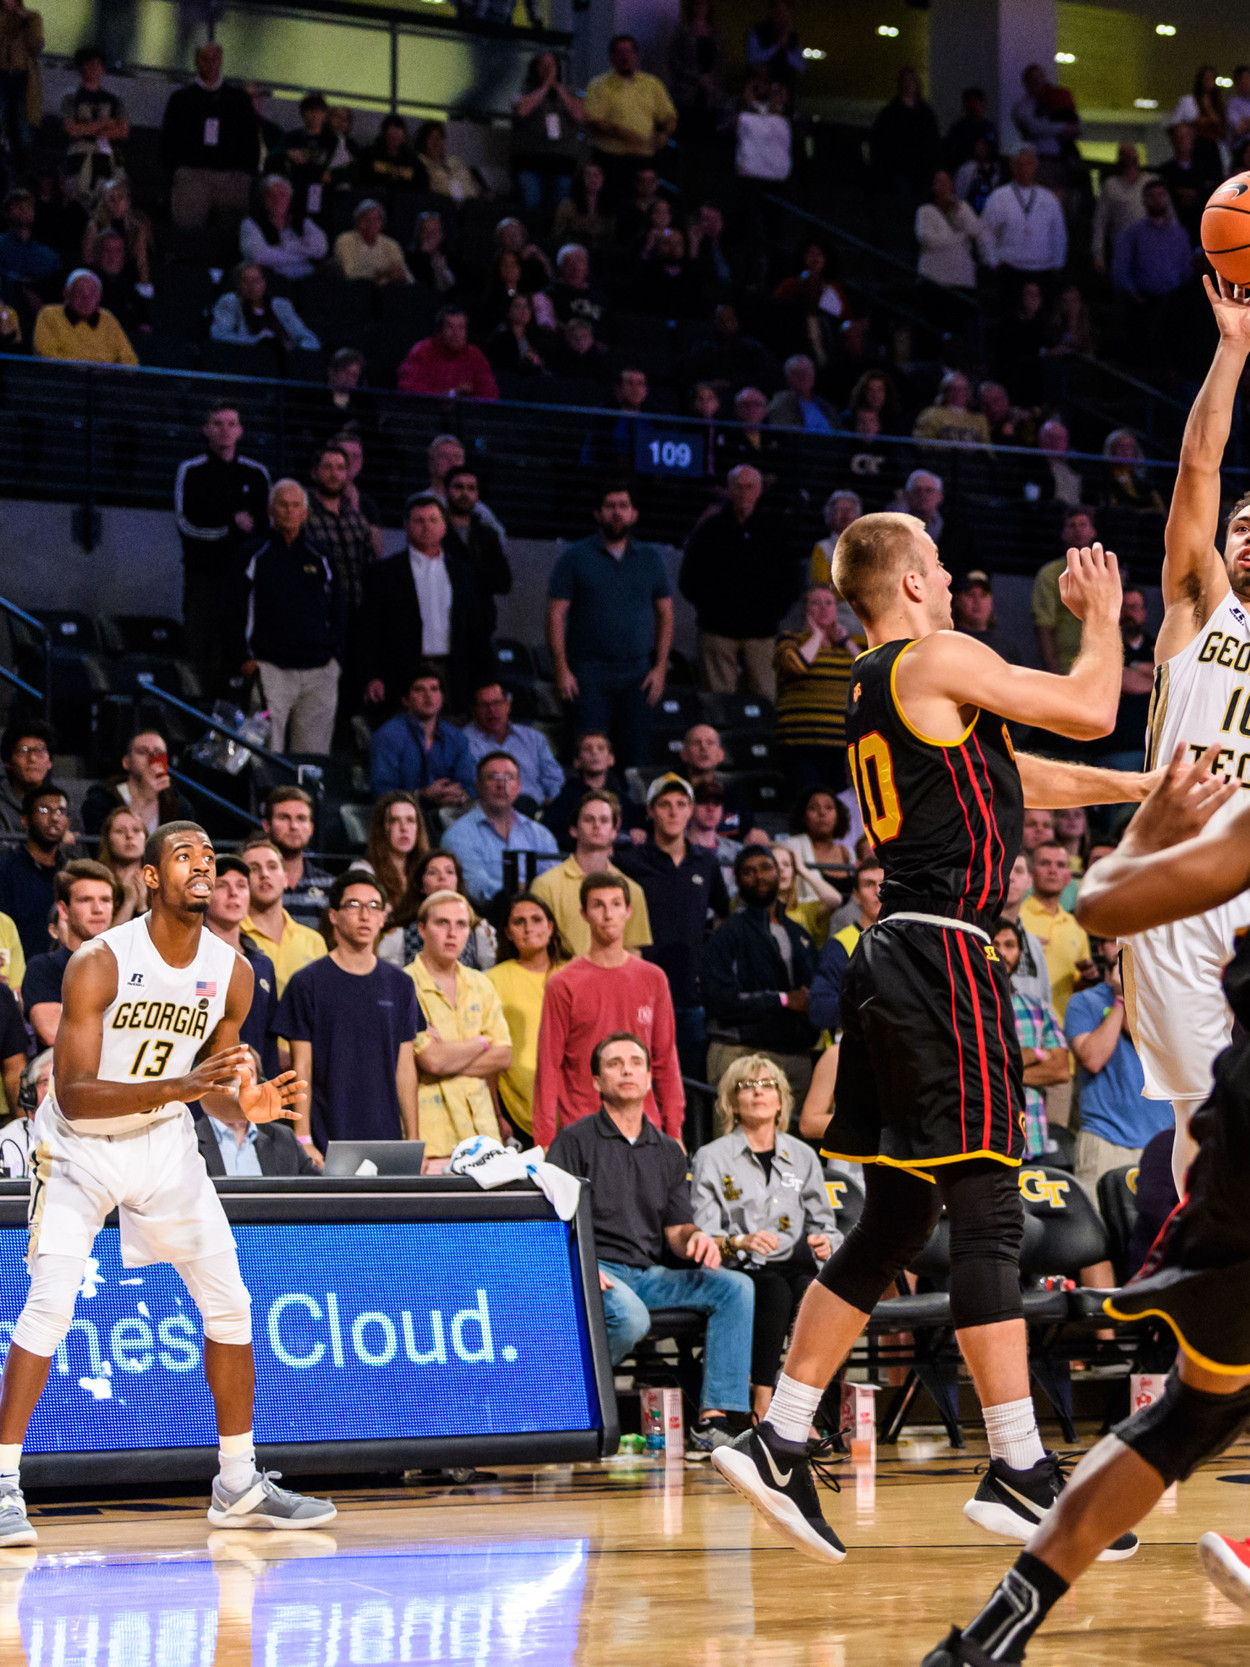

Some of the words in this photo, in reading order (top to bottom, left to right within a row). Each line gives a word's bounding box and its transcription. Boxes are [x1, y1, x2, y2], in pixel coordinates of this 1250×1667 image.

[649, 440, 692, 468] 109
[112, 1001, 208, 1040] GEORGIA
[128, 1039, 174, 1078] 13
[824, 1181, 848, 1209] T
[1018, 1170, 1070, 1208] GT
[267, 1288, 518, 1368] Cloud.
